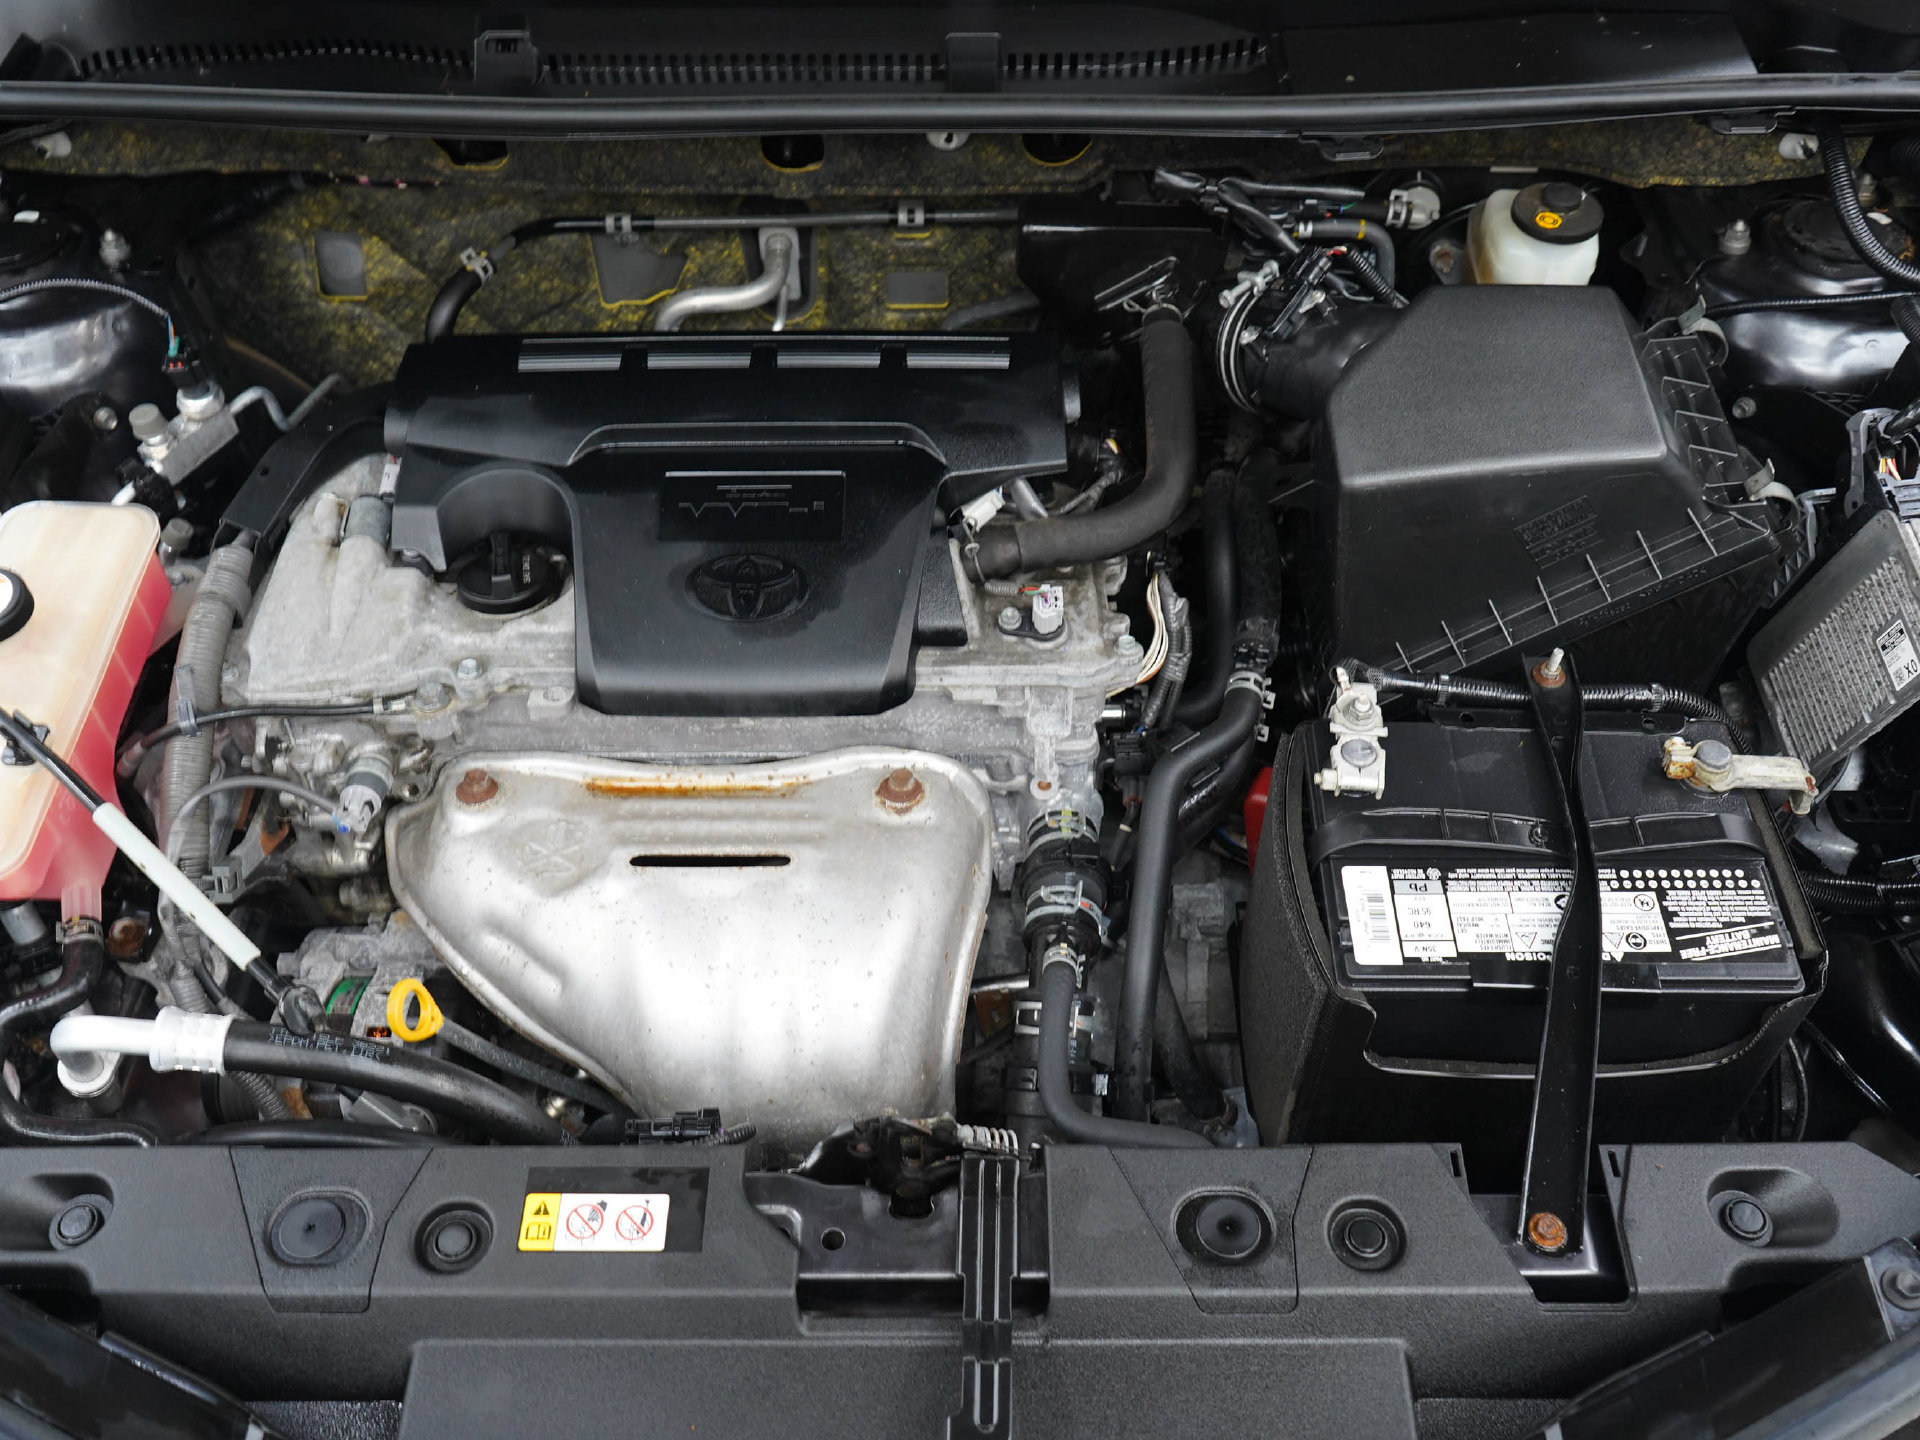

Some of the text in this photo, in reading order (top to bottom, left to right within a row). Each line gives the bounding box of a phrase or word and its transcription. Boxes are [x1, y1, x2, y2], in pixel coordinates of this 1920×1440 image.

[1409, 882, 1428, 892] Pb
[1706, 930, 1750, 946] BATTERY
[1680, 934, 1780, 960] MAINTENANCE-FREE
